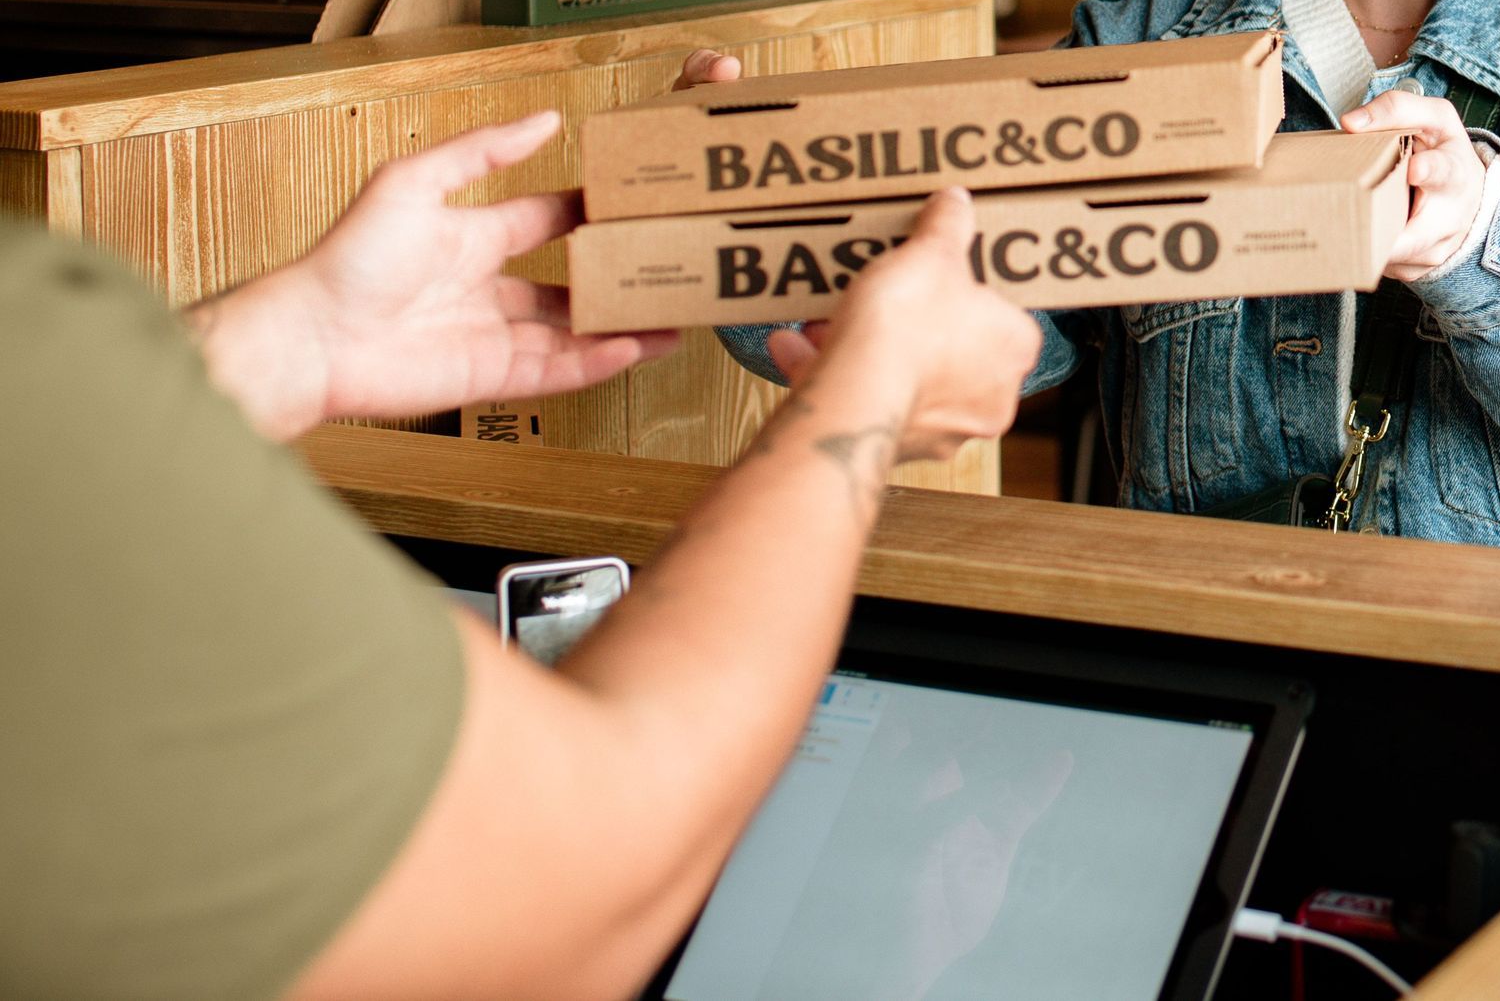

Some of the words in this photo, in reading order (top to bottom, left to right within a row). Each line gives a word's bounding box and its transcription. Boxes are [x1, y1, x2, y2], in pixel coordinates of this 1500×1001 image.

[705, 111, 1141, 192] BASILIC&CO
[716, 220, 1220, 300] BASIC&CO
[477, 414, 519, 444] BAS
